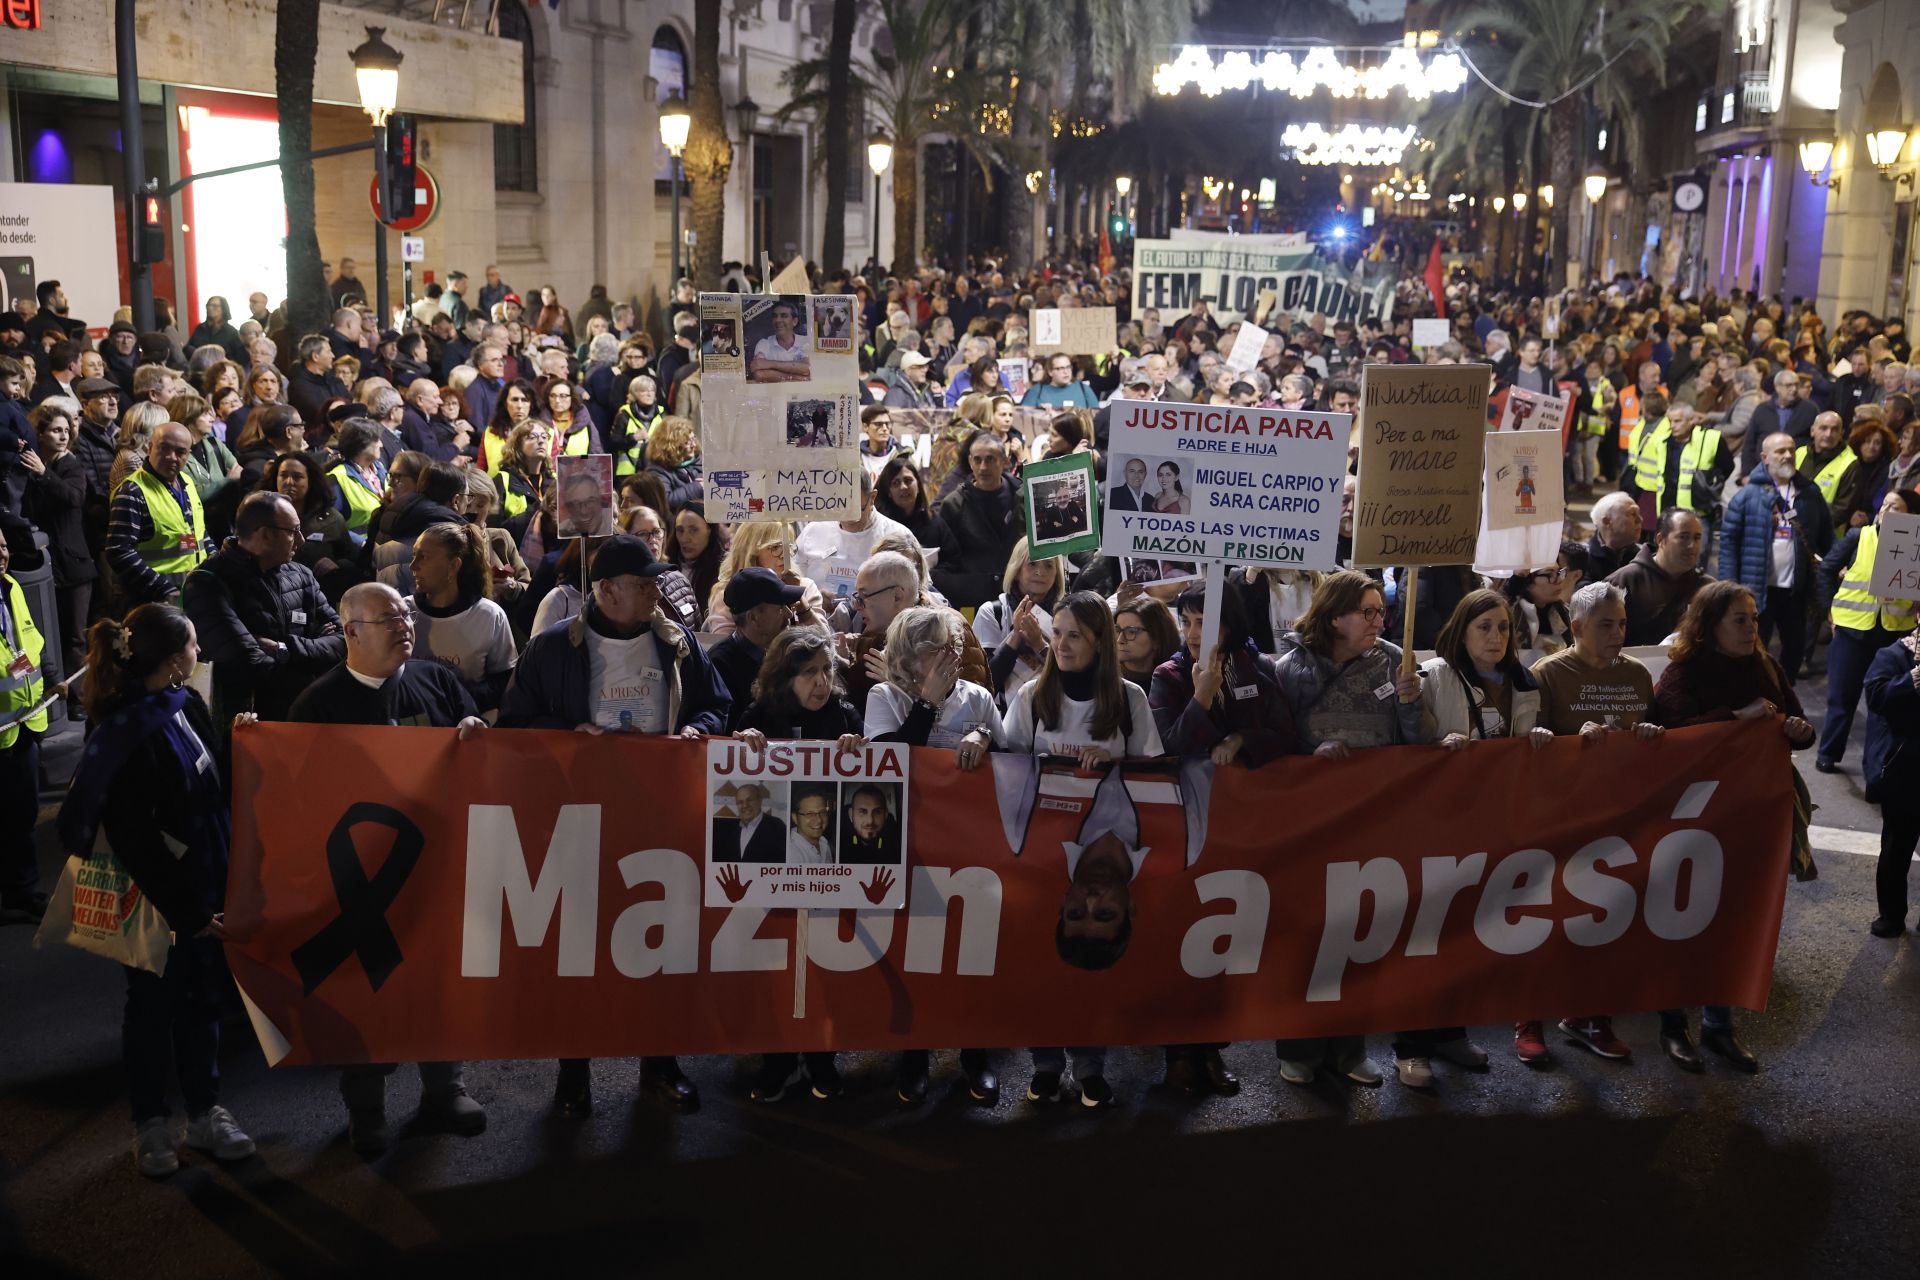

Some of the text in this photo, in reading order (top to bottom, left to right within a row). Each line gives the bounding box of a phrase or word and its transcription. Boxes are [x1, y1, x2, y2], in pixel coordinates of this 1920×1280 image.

[9, 232, 36, 244] desde:
[1143, 253, 1154, 266] EL
[1155, 253, 1187, 267] FUTUR
[1188, 253, 1201, 267] EN
[1229, 256, 1248, 269] DEL
[1249, 256, 1279, 271] POBLE
[821, 338, 848, 348] MAMBO
[1125, 408, 1334, 440] JUSTICIA PARA
[1375, 420, 1460, 445] Per a ma
[1178, 438, 1277, 455] PADRE E HIJA
[1389, 450, 1457, 472] mare
[1196, 469, 1340, 493] MIGUEL CARPIO Y
[710, 487, 753, 500] RATA
[799, 486, 817, 495] AL
[729, 502, 746, 510] MAL
[1209, 492, 1320, 513] SARA CARPIO
[1121, 516, 1320, 541] Y TODAS LAS VICTIMAS
[1132, 535, 1304, 561] MAZÓN PRISIÓN
[836, 566, 859, 576] PRES
[1888, 569, 1920, 590] AS
[599, 684, 650, 699] A PRESÓ
[1581, 685, 1635, 693] 229 fallecidos
[1587, 693, 1639, 701] responsables
[1570, 703, 1648, 711] VALENCIA NO OLVIDA
[713, 745, 904, 777] JUSTICIA
[76, 868, 130, 893] CARRIES
[760, 865, 852, 878] por mi marido
[771, 882, 841, 894] y mis hijos
[1180, 870, 1270, 978] a
[1306, 781, 1724, 1002] presó
[74, 887, 116, 910] WATER
[72, 906, 121, 931] MELONS
